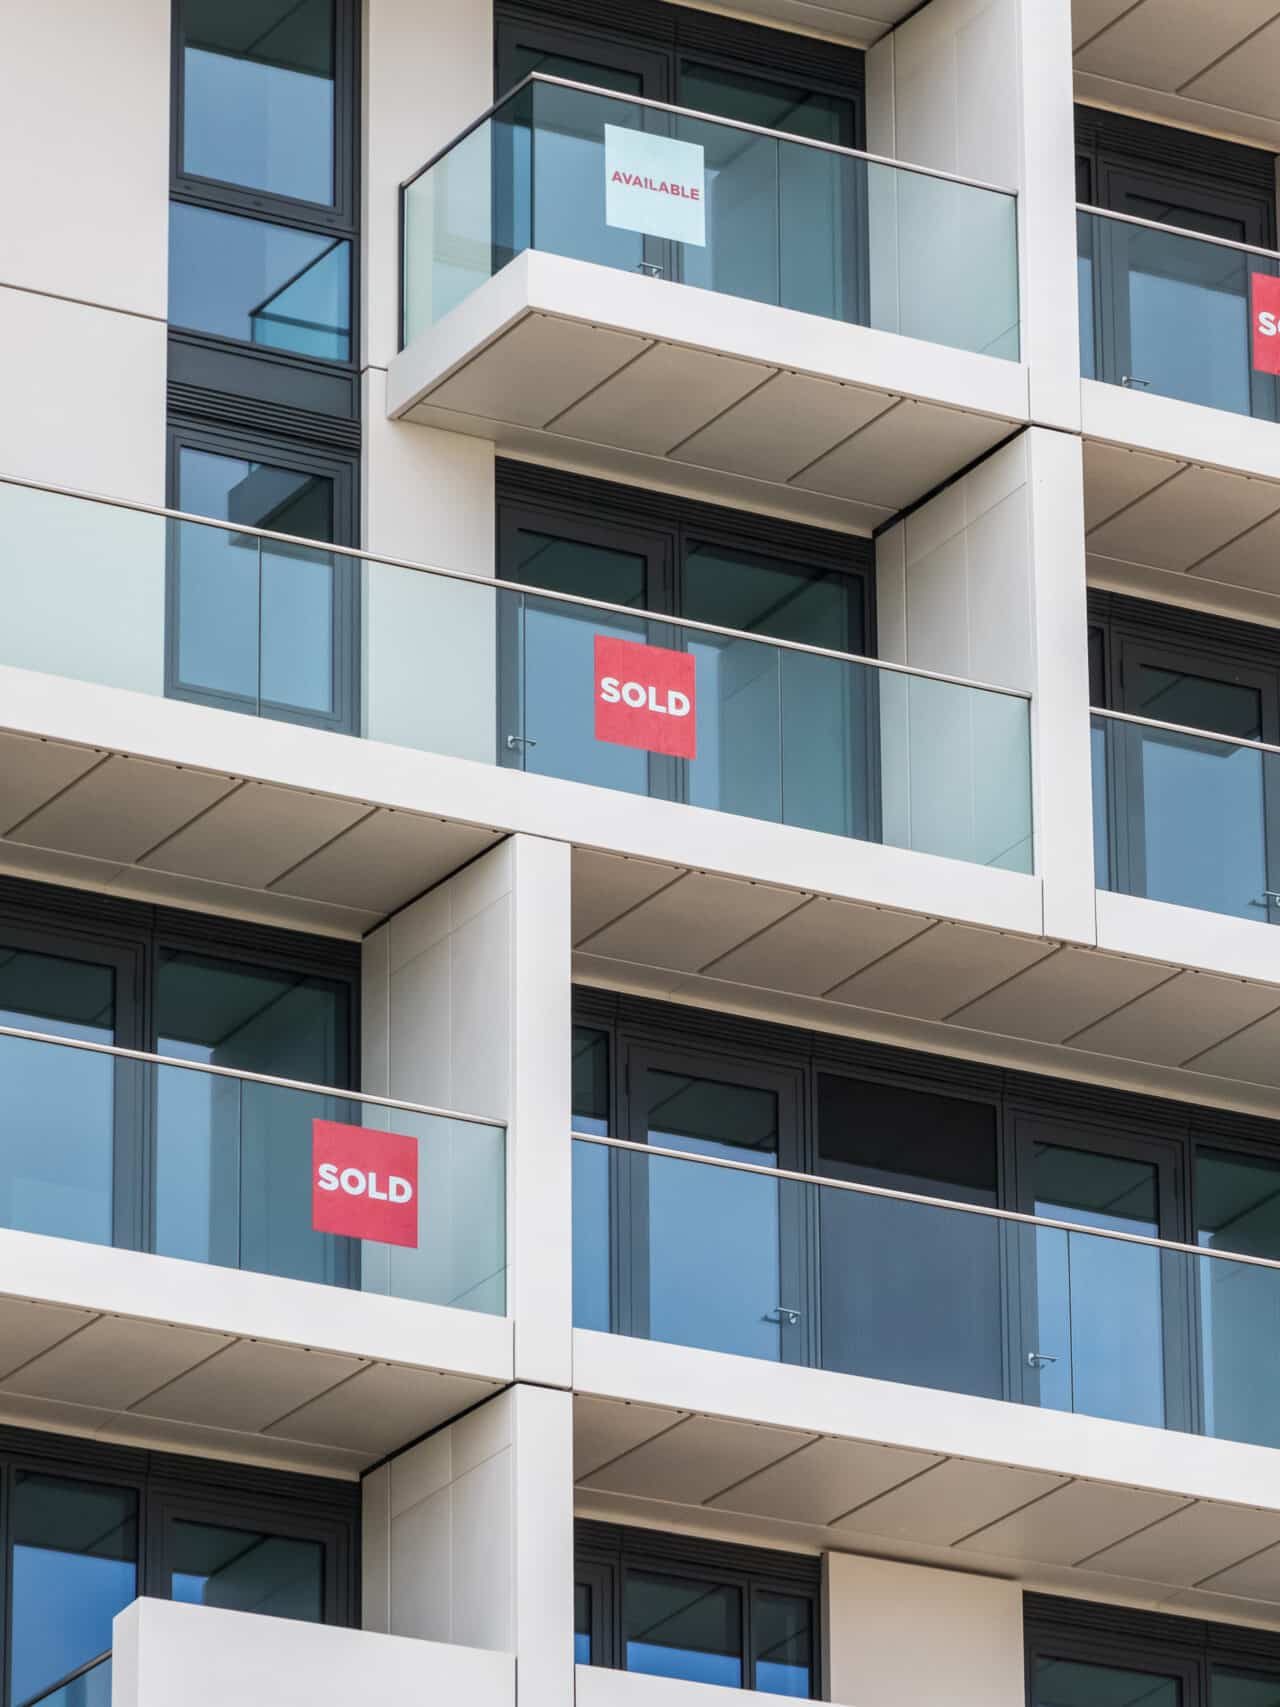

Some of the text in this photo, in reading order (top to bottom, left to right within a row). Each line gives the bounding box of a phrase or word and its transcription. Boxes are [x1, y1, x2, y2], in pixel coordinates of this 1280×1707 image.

[611, 170, 700, 201] AVAILABLE
[599, 676, 691, 717] SOLD
[317, 1162, 413, 1205] SOLD
